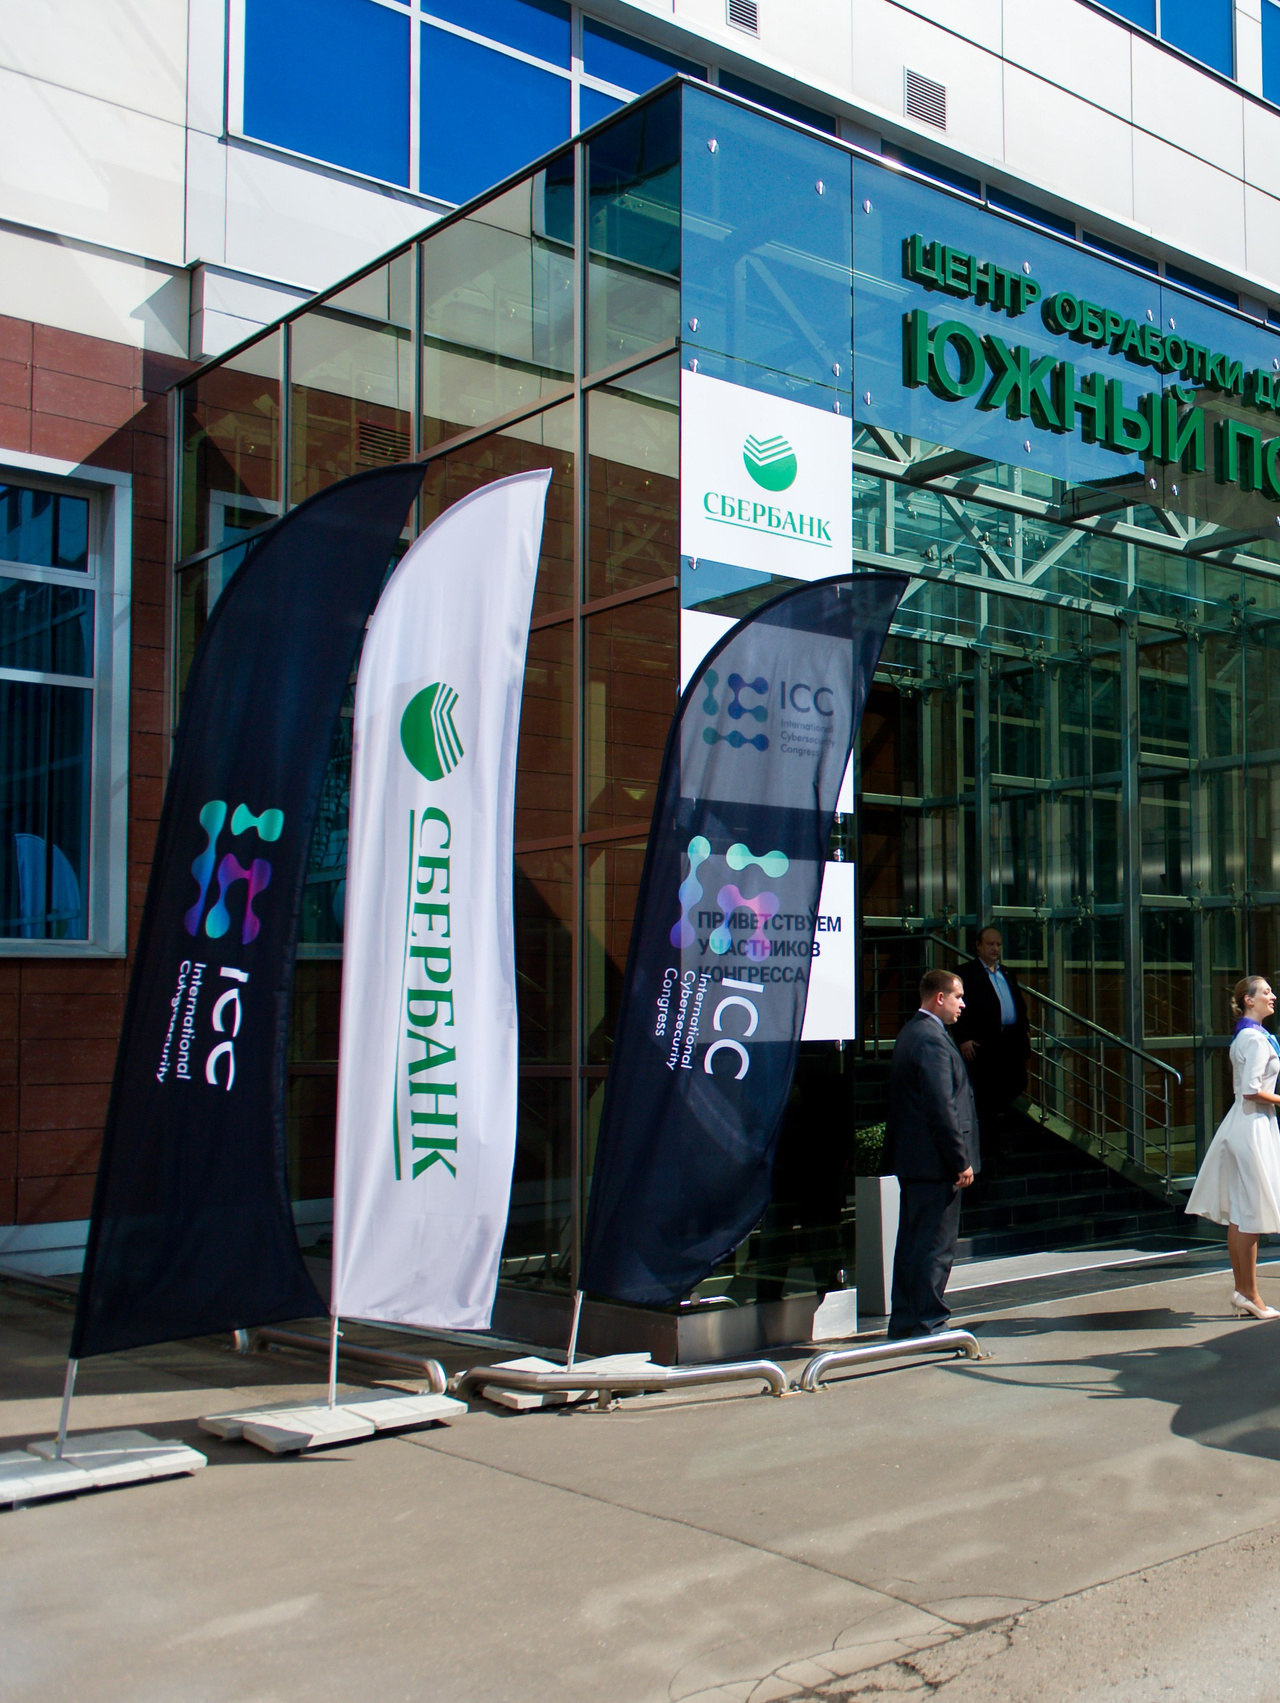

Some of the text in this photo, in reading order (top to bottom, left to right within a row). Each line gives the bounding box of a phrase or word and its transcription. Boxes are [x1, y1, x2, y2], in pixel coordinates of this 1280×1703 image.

[903, 233, 1042, 317] ЦЕНТР
[1041, 291, 1244, 395] ОБРАБОТКИ
[903, 308, 1205, 475] ЮЖНЫЙ
[703, 492, 832, 541] СБЕРБАНК
[781, 681, 834, 716] ICC
[698, 911, 842, 932] ПРИВЕТСТВУЕМ
[698, 939, 821, 957] УЧАСТНИКОВ
[176, 963, 207, 1080] International
[406, 806, 458, 1181] СБЕРБАНК
[655, 968, 678, 1037] Congress
[666, 970, 697, 1071] Cybersecurity
[680, 973, 712, 1069] International
[699, 966, 806, 983] КОНГРЕССА
[206, 966, 249, 1091] ICC
[704, 977, 764, 1080] ICC
